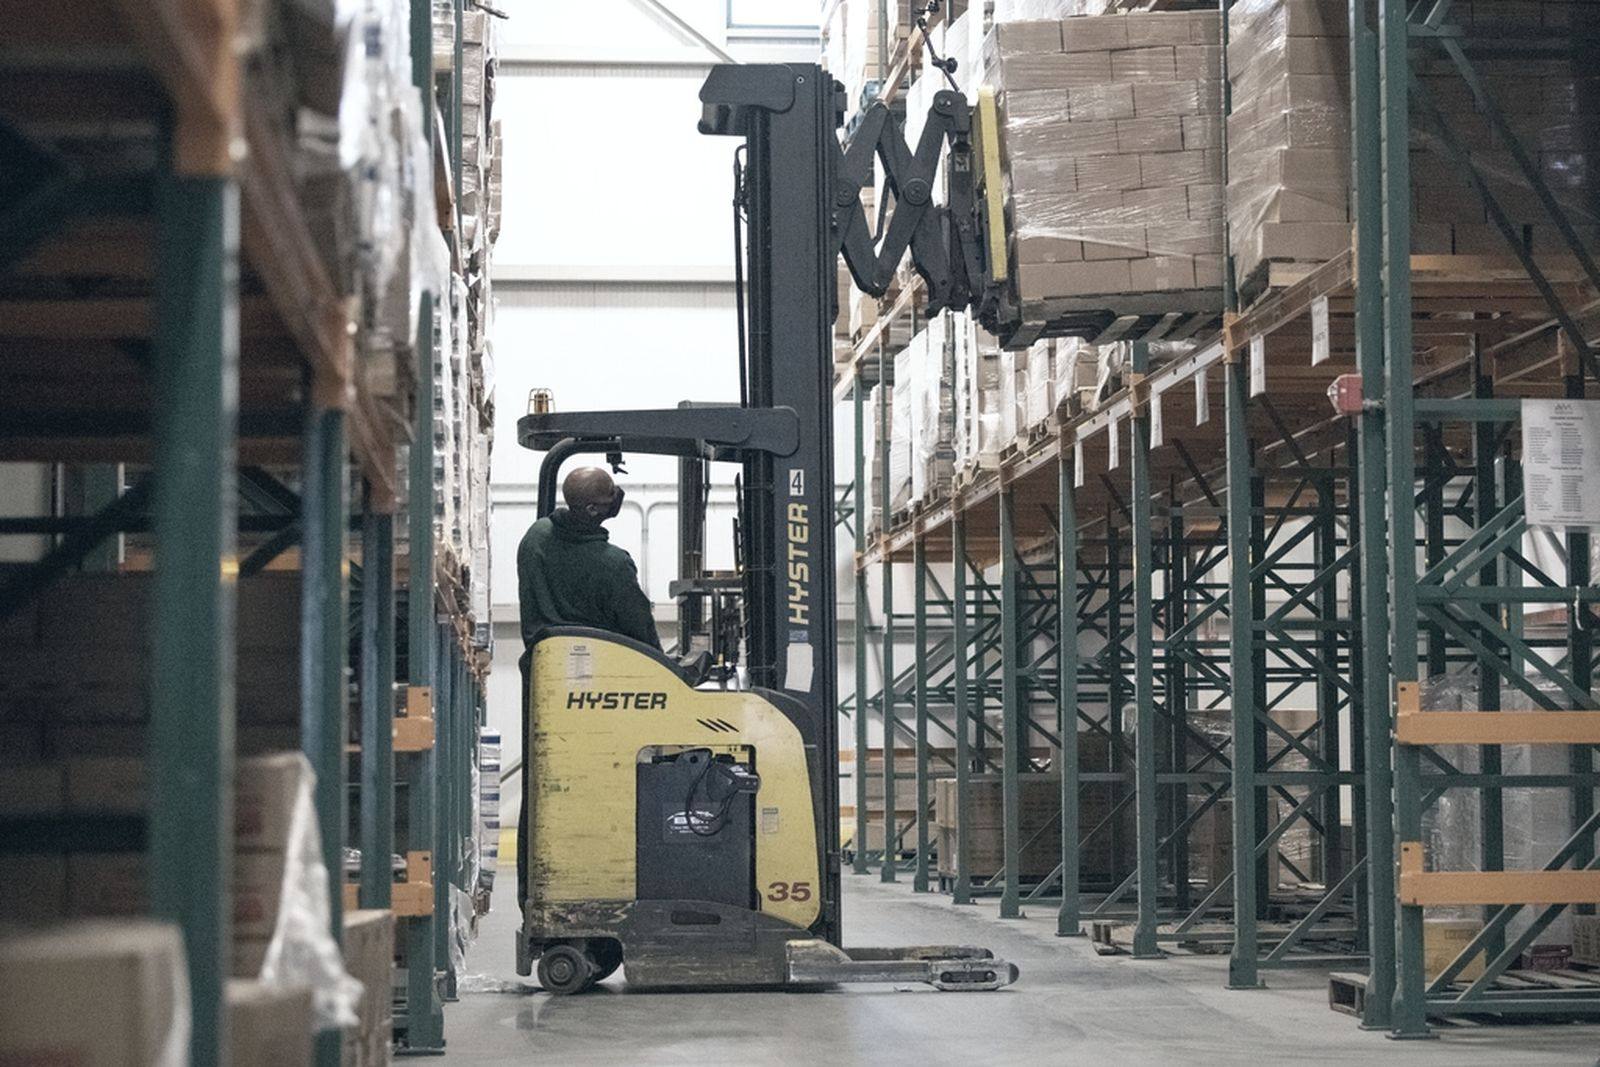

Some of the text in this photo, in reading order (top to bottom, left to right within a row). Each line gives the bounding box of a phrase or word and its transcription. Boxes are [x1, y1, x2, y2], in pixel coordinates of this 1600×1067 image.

[791, 471, 803, 495] 4
[788, 502, 809, 625] HYSTER
[566, 692, 667, 710] HYSTER
[767, 881, 811, 903] 35
